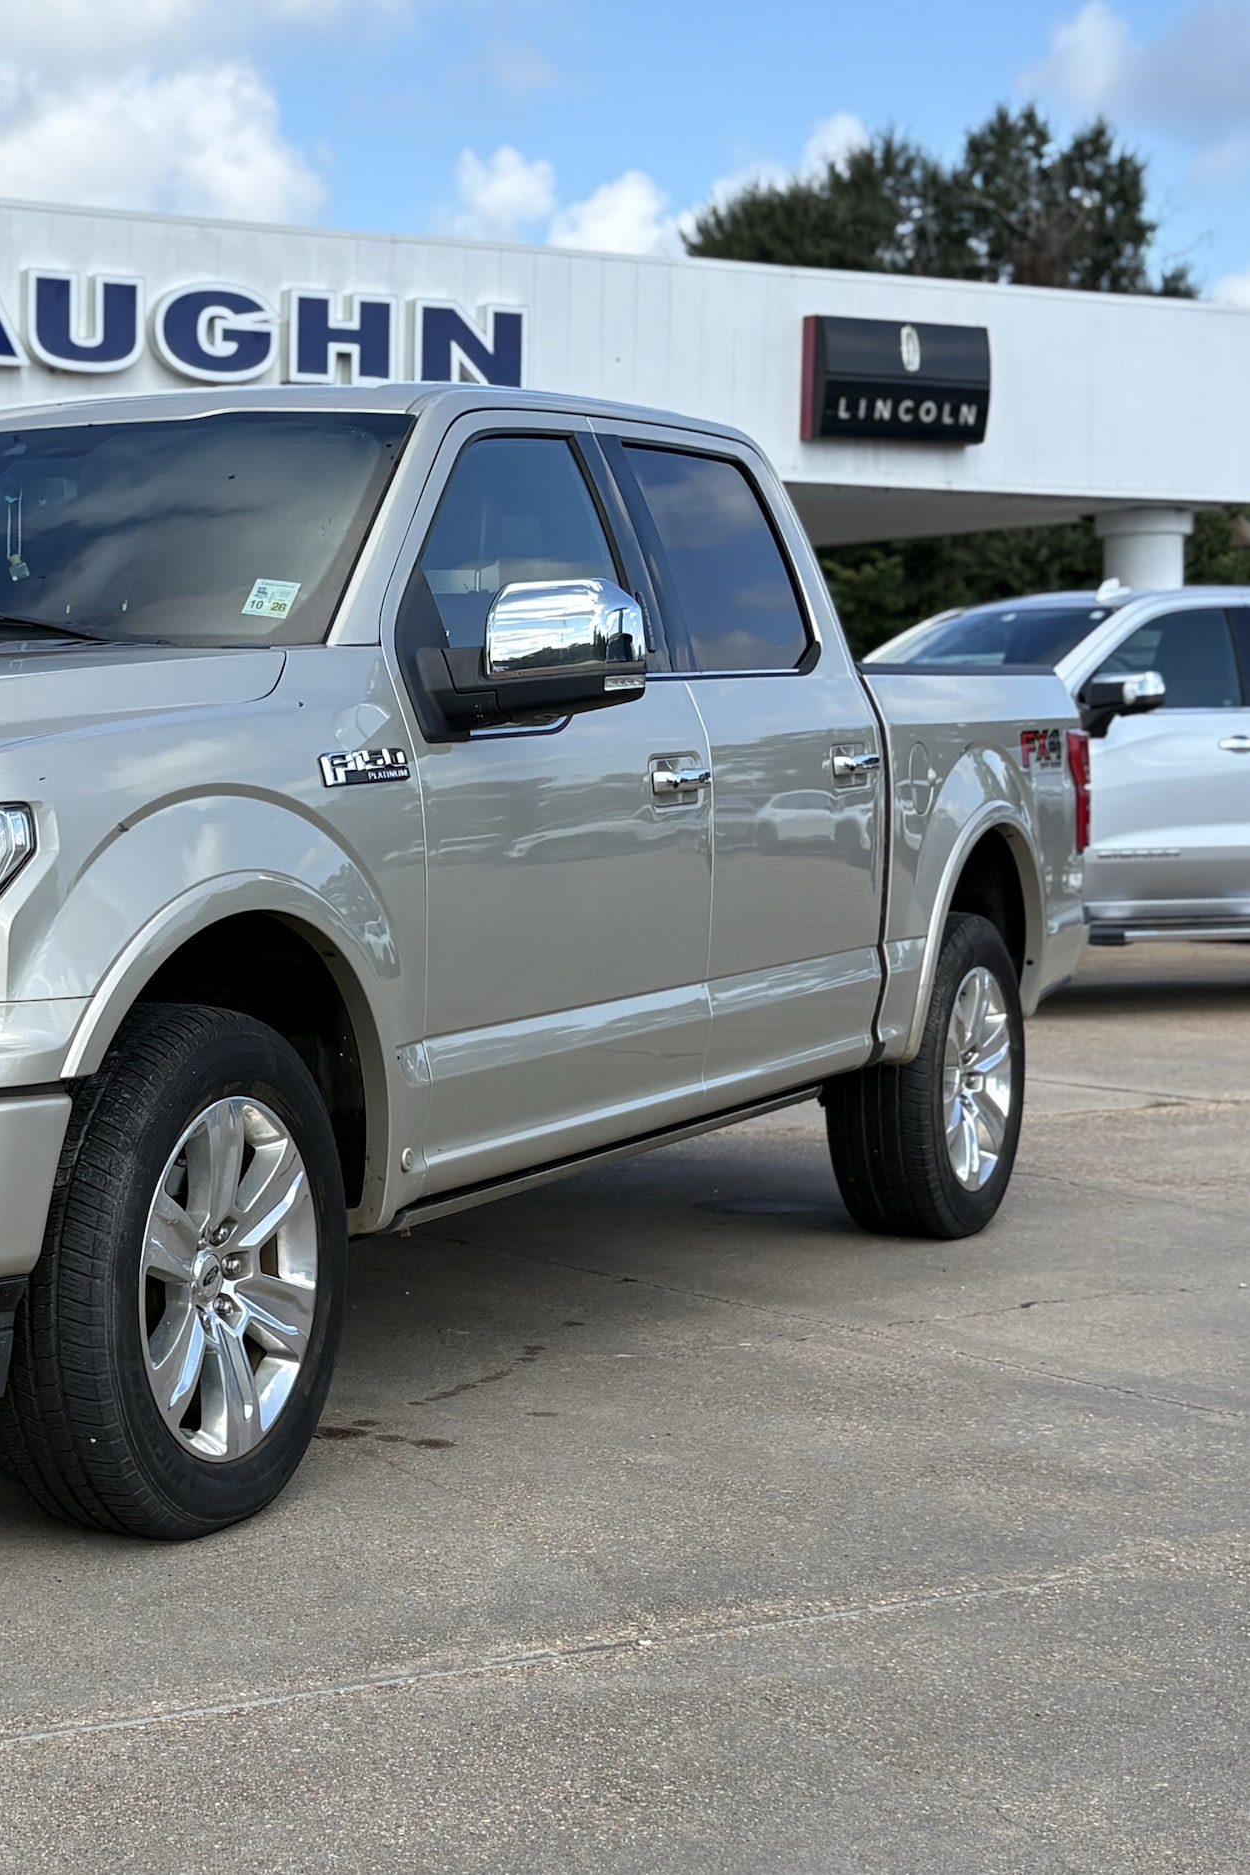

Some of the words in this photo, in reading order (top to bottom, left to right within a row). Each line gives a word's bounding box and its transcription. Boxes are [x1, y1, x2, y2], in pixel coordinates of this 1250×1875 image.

[837, 396, 978, 427] LINCOLN
[250, 600, 264, 610] 10
[270, 602, 287, 612] 26
[1021, 729, 1061, 768] FX4
[368, 768, 408, 780] PLATINUM
